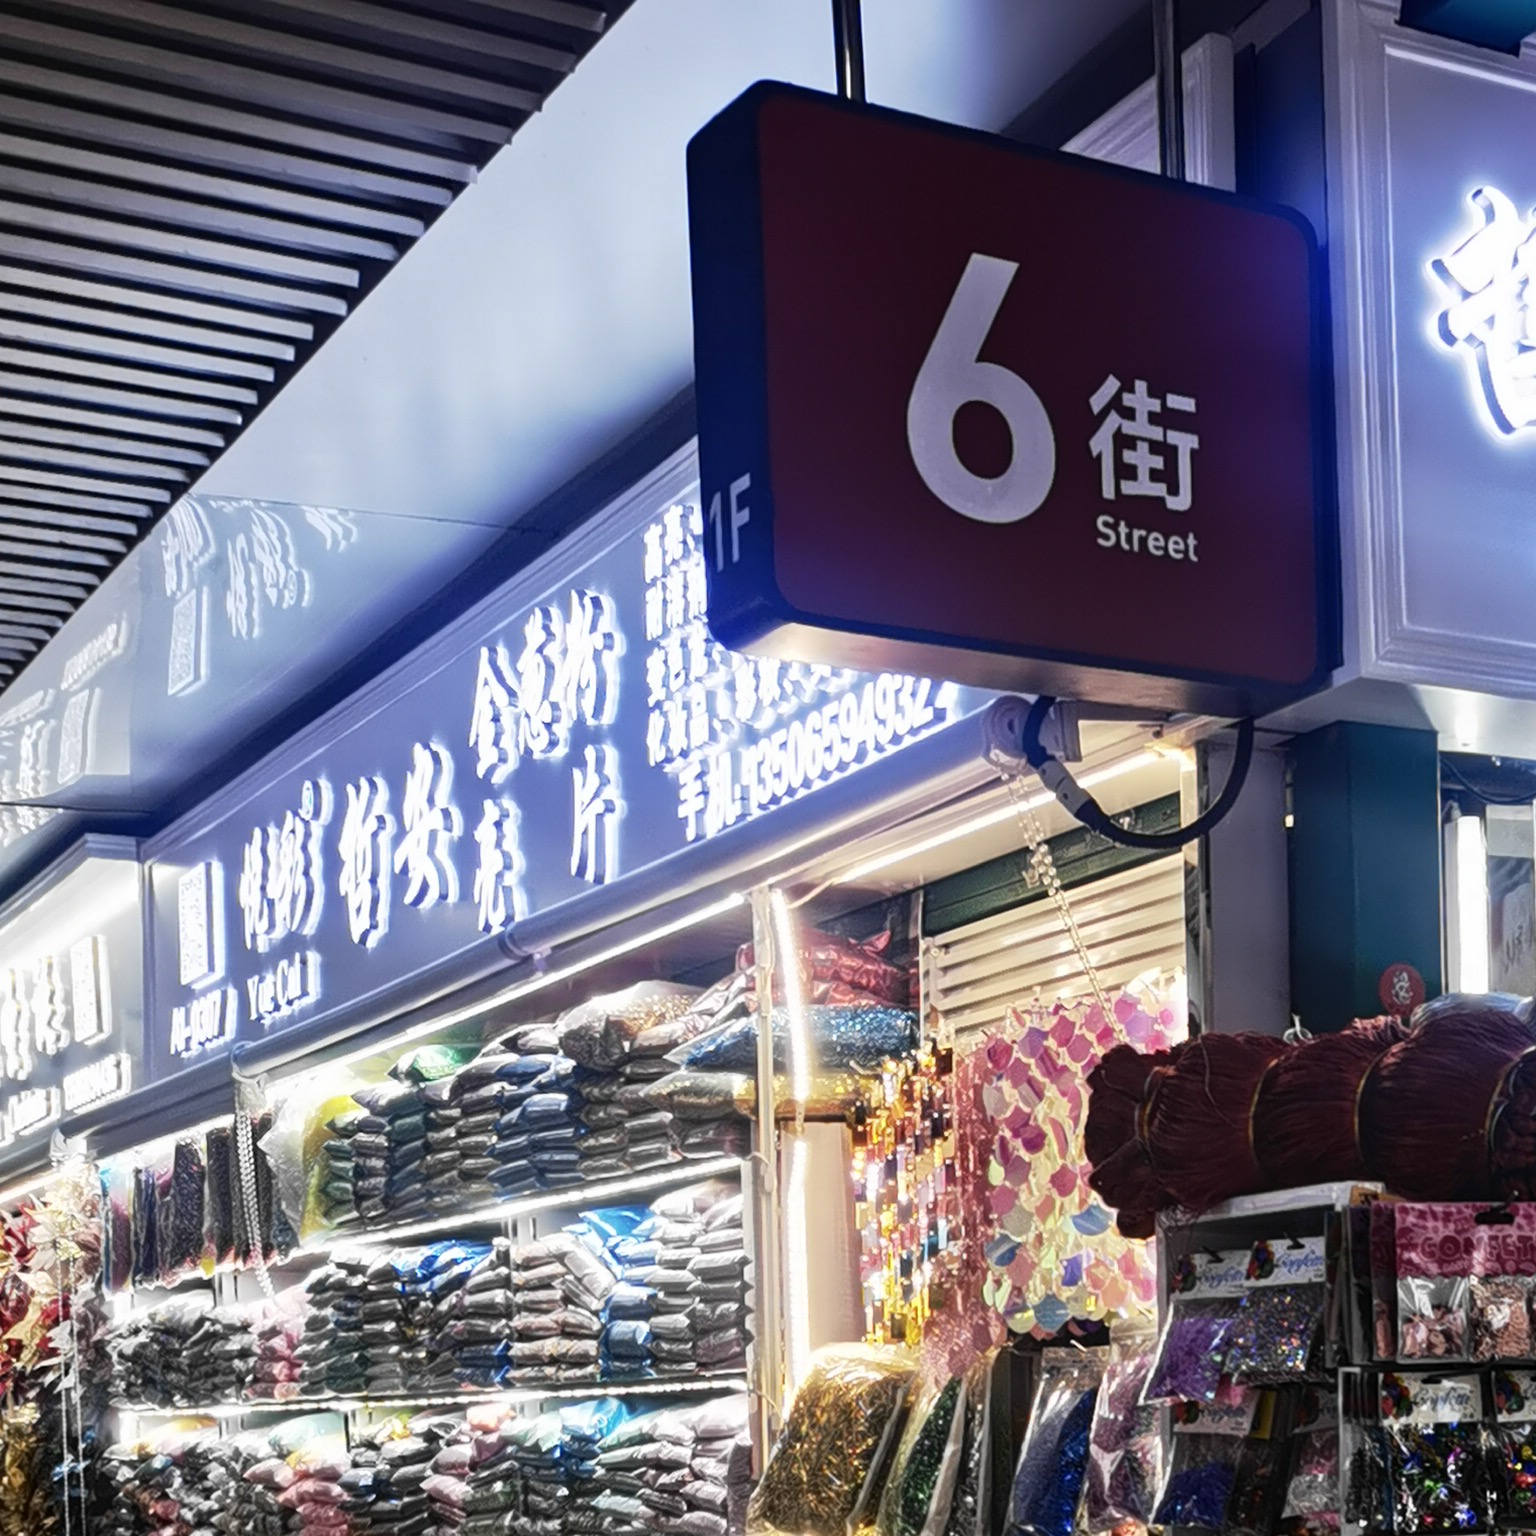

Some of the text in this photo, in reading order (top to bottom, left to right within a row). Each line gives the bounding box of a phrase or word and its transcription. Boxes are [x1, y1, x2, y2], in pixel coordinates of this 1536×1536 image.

[709, 472, 753, 573] 1F
[1096, 515, 1199, 562] Street
[339, 742, 446, 945] 哲安
[1273, 1251, 1324, 1277] Confetti
[1409, 1387, 1471, 1414] Confetti
